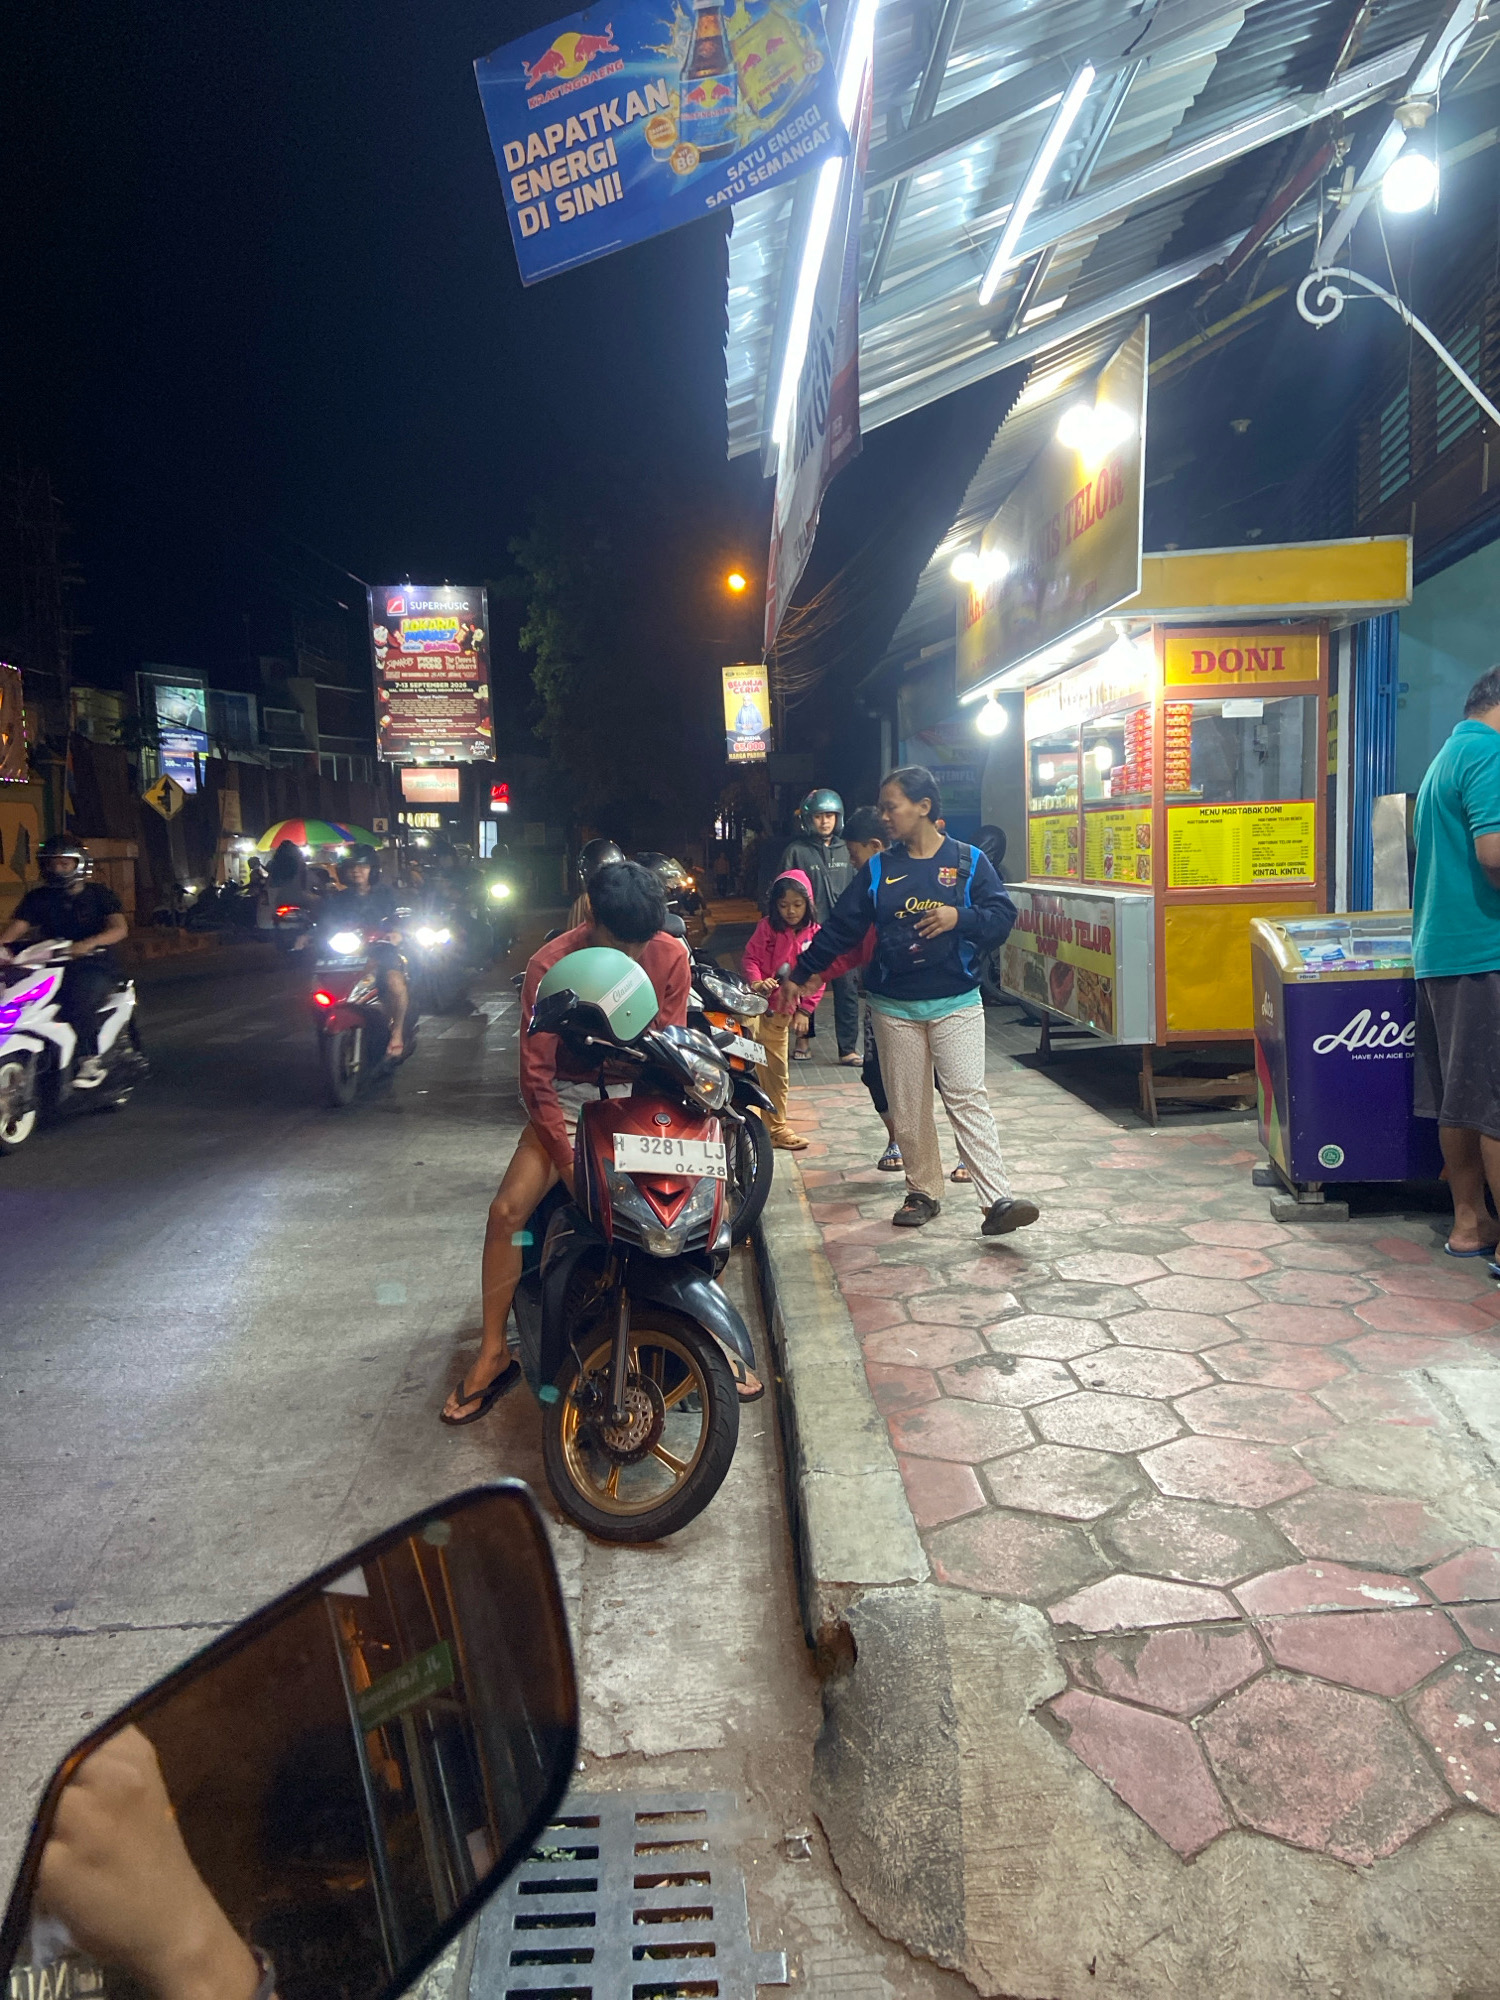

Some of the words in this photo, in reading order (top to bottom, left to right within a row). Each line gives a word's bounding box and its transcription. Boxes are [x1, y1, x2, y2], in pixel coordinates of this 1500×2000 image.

[527, 59, 624, 110] KRATINGDAENG
[503, 78, 670, 172] DAPATKAN
[727, 145, 766, 181] SATU
[767, 104, 821, 154] ENERGI
[510, 137, 617, 204] ENERGI
[705, 178, 745, 208] SATU
[747, 122, 831, 187] SEMANGAT
[517, 203, 550, 237] DI
[558, 171, 623, 222] SINI!
[1065, 456, 1123, 546] TELOR
[410, 601, 469, 610] SUPERMUSIC
[1191, 646, 1286, 674] DONI
[728, 680, 763, 690] BELANJA
[733, 686, 760, 695] CERIA
[1200, 808, 1220, 816] MENU
[1222, 806, 1263, 815] MARTABAK
[1264, 806, 1283, 814] DONI
[1280, 867, 1306, 875] KINTUL
[905, 896, 944, 913] Qatar
[1074, 919, 1112, 955] TELUR
[1313, 1009, 1415, 1054] Aice
[614, 1136, 624, 1151] H
[640, 1137, 684, 1156] 3281
[704, 1142, 724, 1159] LJ
